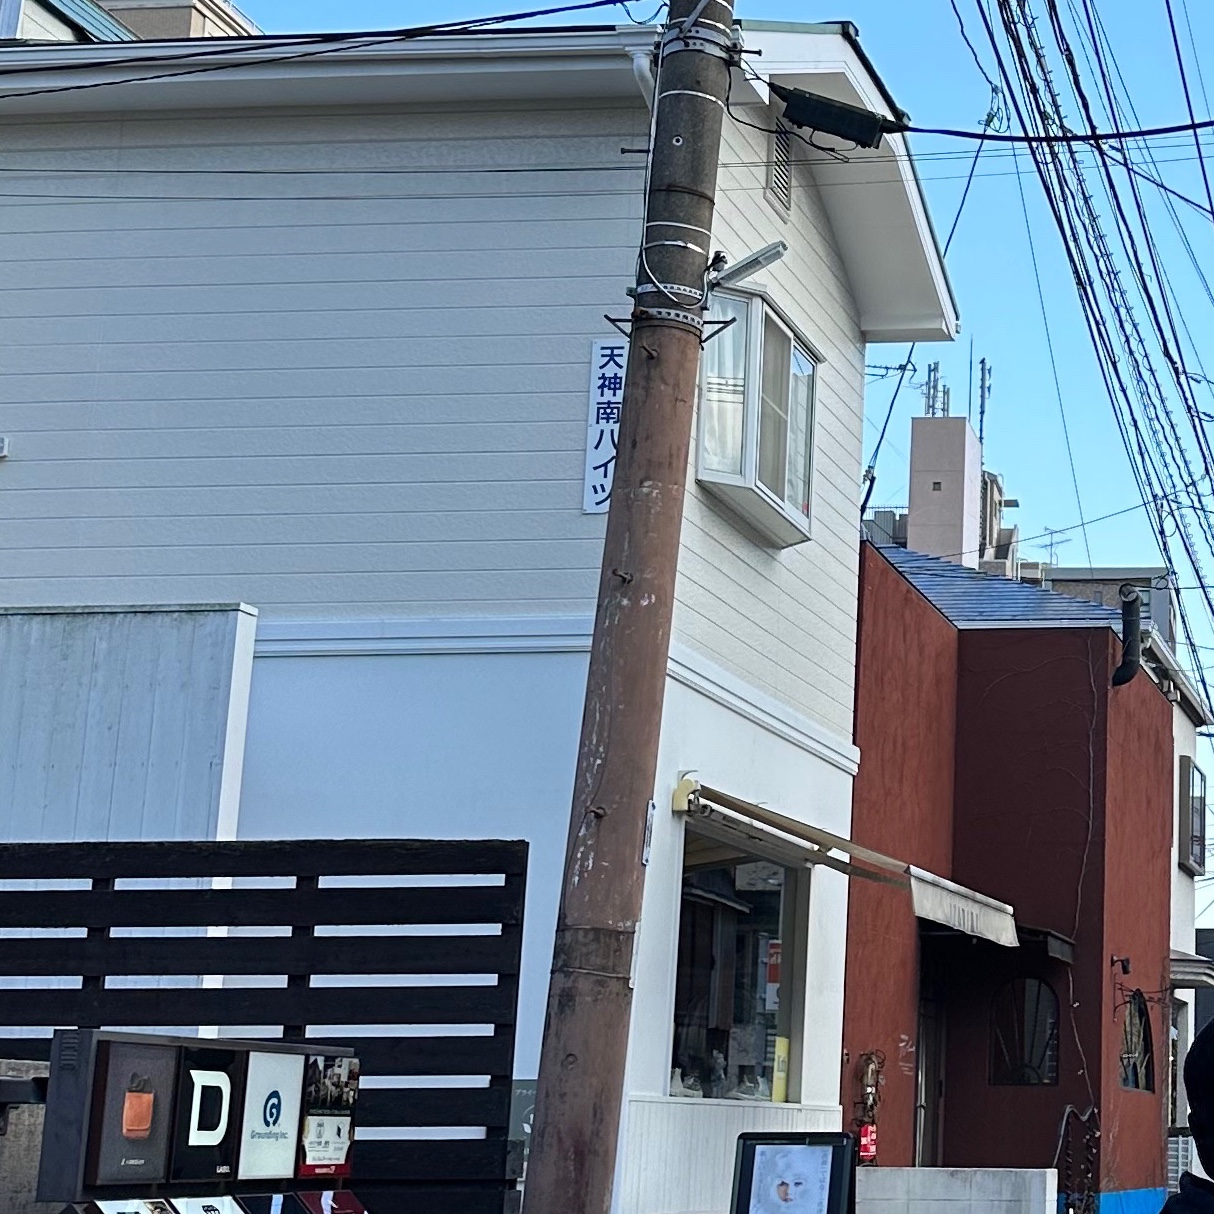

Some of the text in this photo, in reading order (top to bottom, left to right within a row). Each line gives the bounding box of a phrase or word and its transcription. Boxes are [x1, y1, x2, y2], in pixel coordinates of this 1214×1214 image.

[591, 345, 625, 506] 天神南ハイツ
[188, 1070, 232, 1146] D
